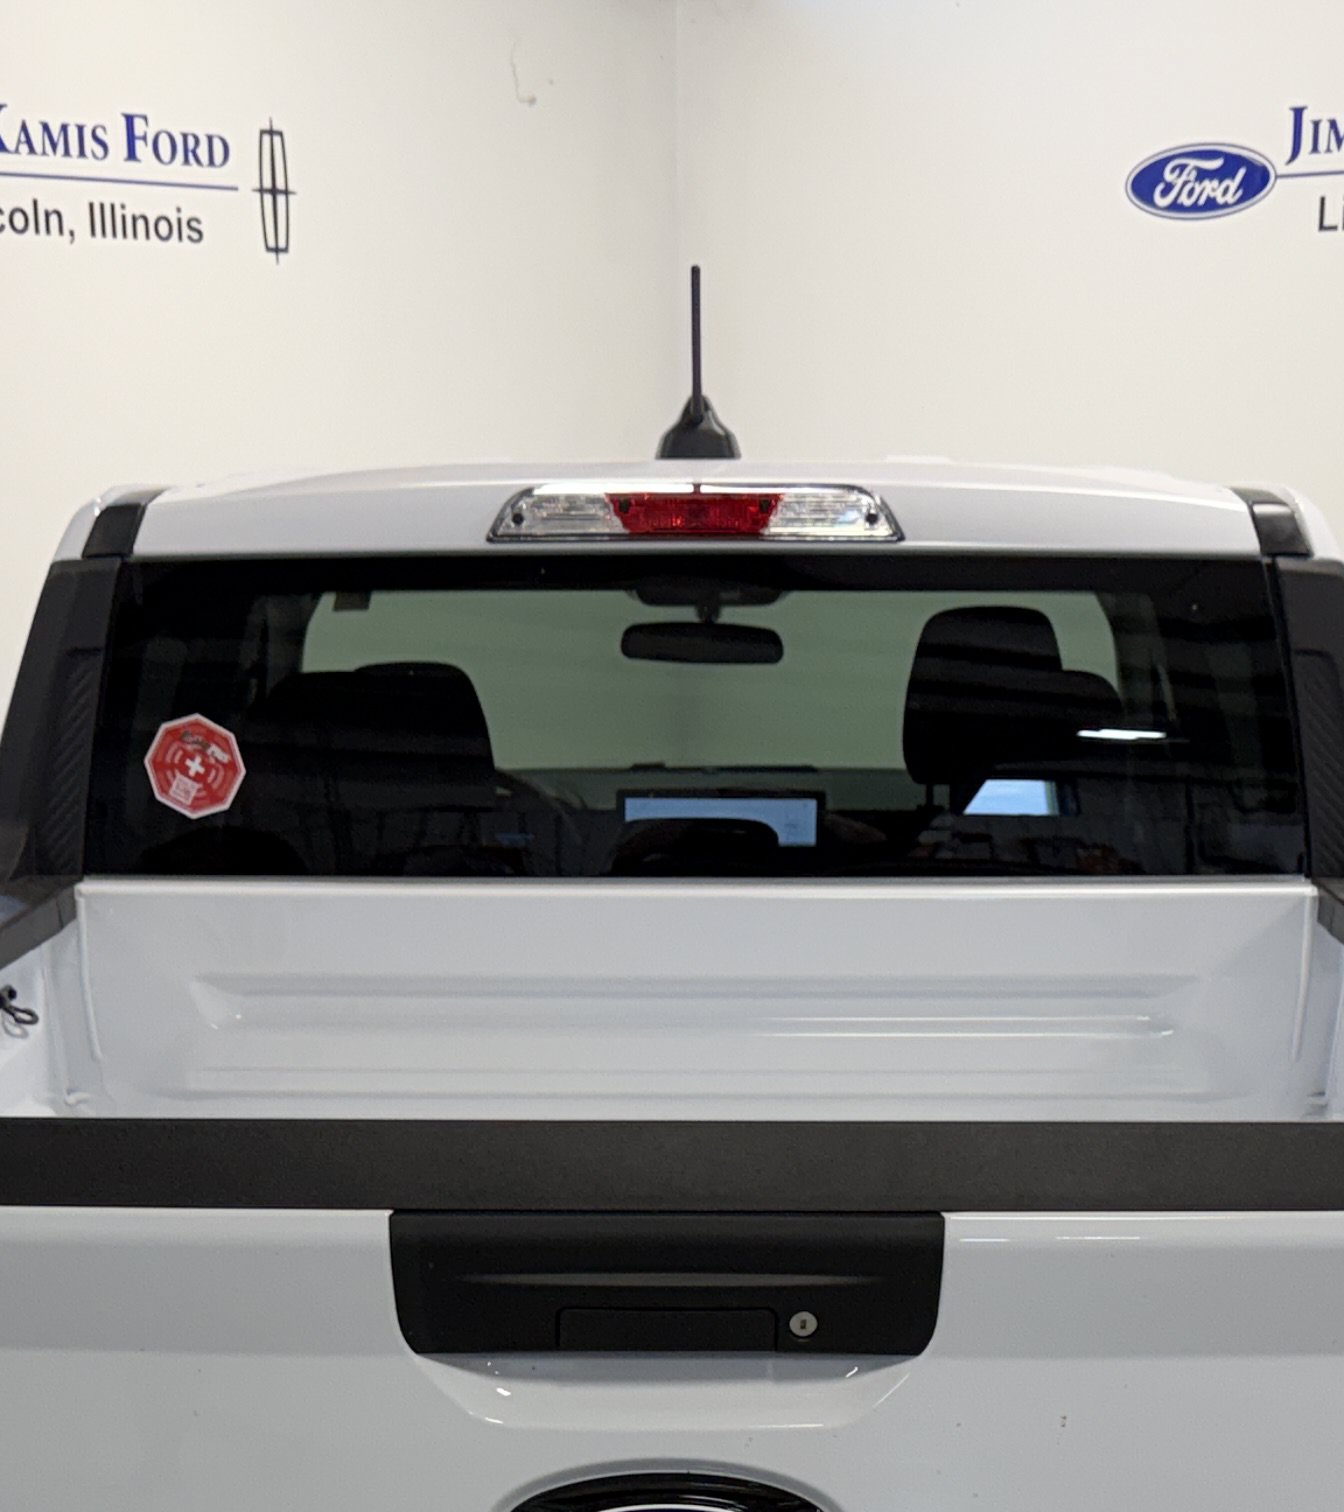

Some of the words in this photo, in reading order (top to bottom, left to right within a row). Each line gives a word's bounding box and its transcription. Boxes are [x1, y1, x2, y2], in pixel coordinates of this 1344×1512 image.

[121, 113, 230, 168] FORD
[1153, 157, 1248, 207] Ford
[89, 200, 204, 243] Illinois
